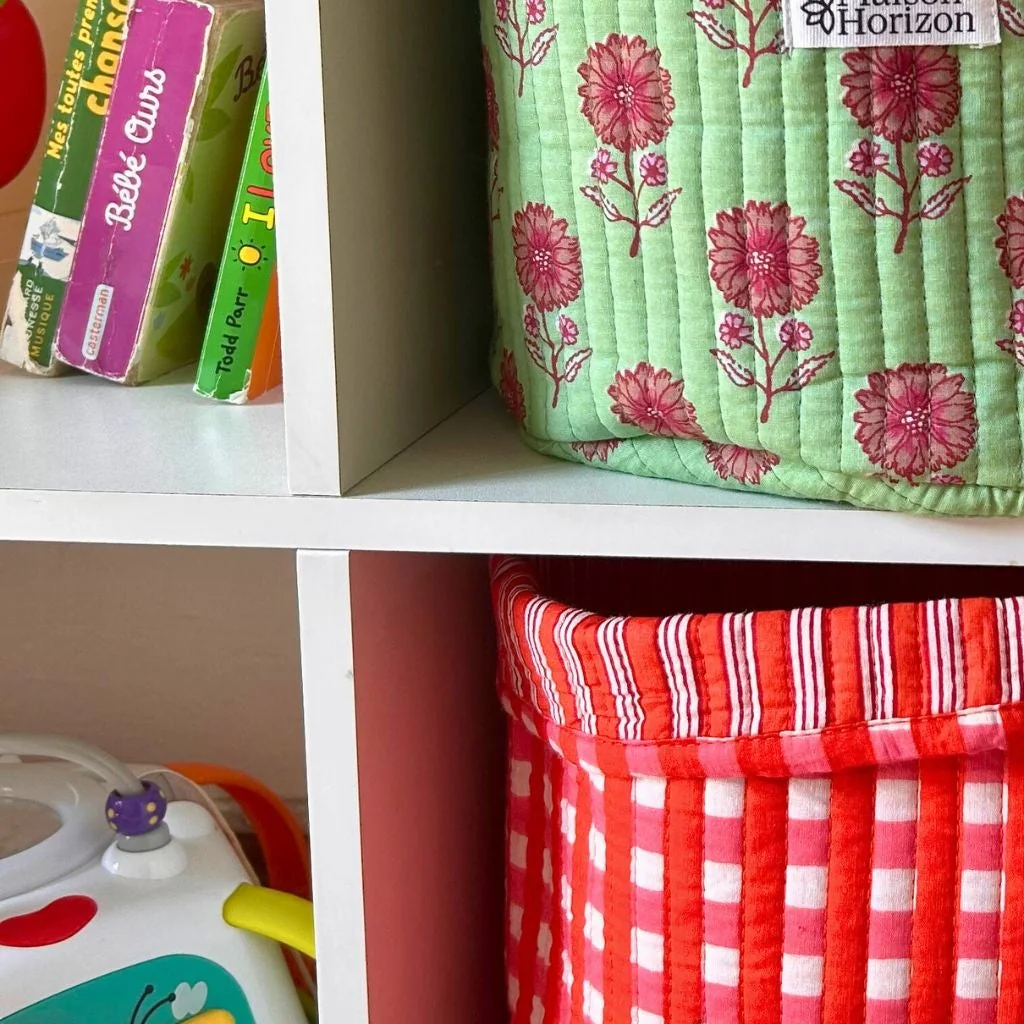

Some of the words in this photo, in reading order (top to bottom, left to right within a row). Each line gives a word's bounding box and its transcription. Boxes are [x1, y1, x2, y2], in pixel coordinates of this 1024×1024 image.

[837, 7, 976, 36] Horizon
[57, 49, 85, 115] toutes
[124, 67, 167, 144] Ours
[46, 120, 69, 160] Mes
[104, 151, 147, 232] Bébé
[242, 202, 275, 230] I
[30, 293, 55, 358] MUSIQUE
[86, 289, 109, 356] casterman
[225, 286, 249, 328] Parr
[215, 334, 239, 374] Todd
